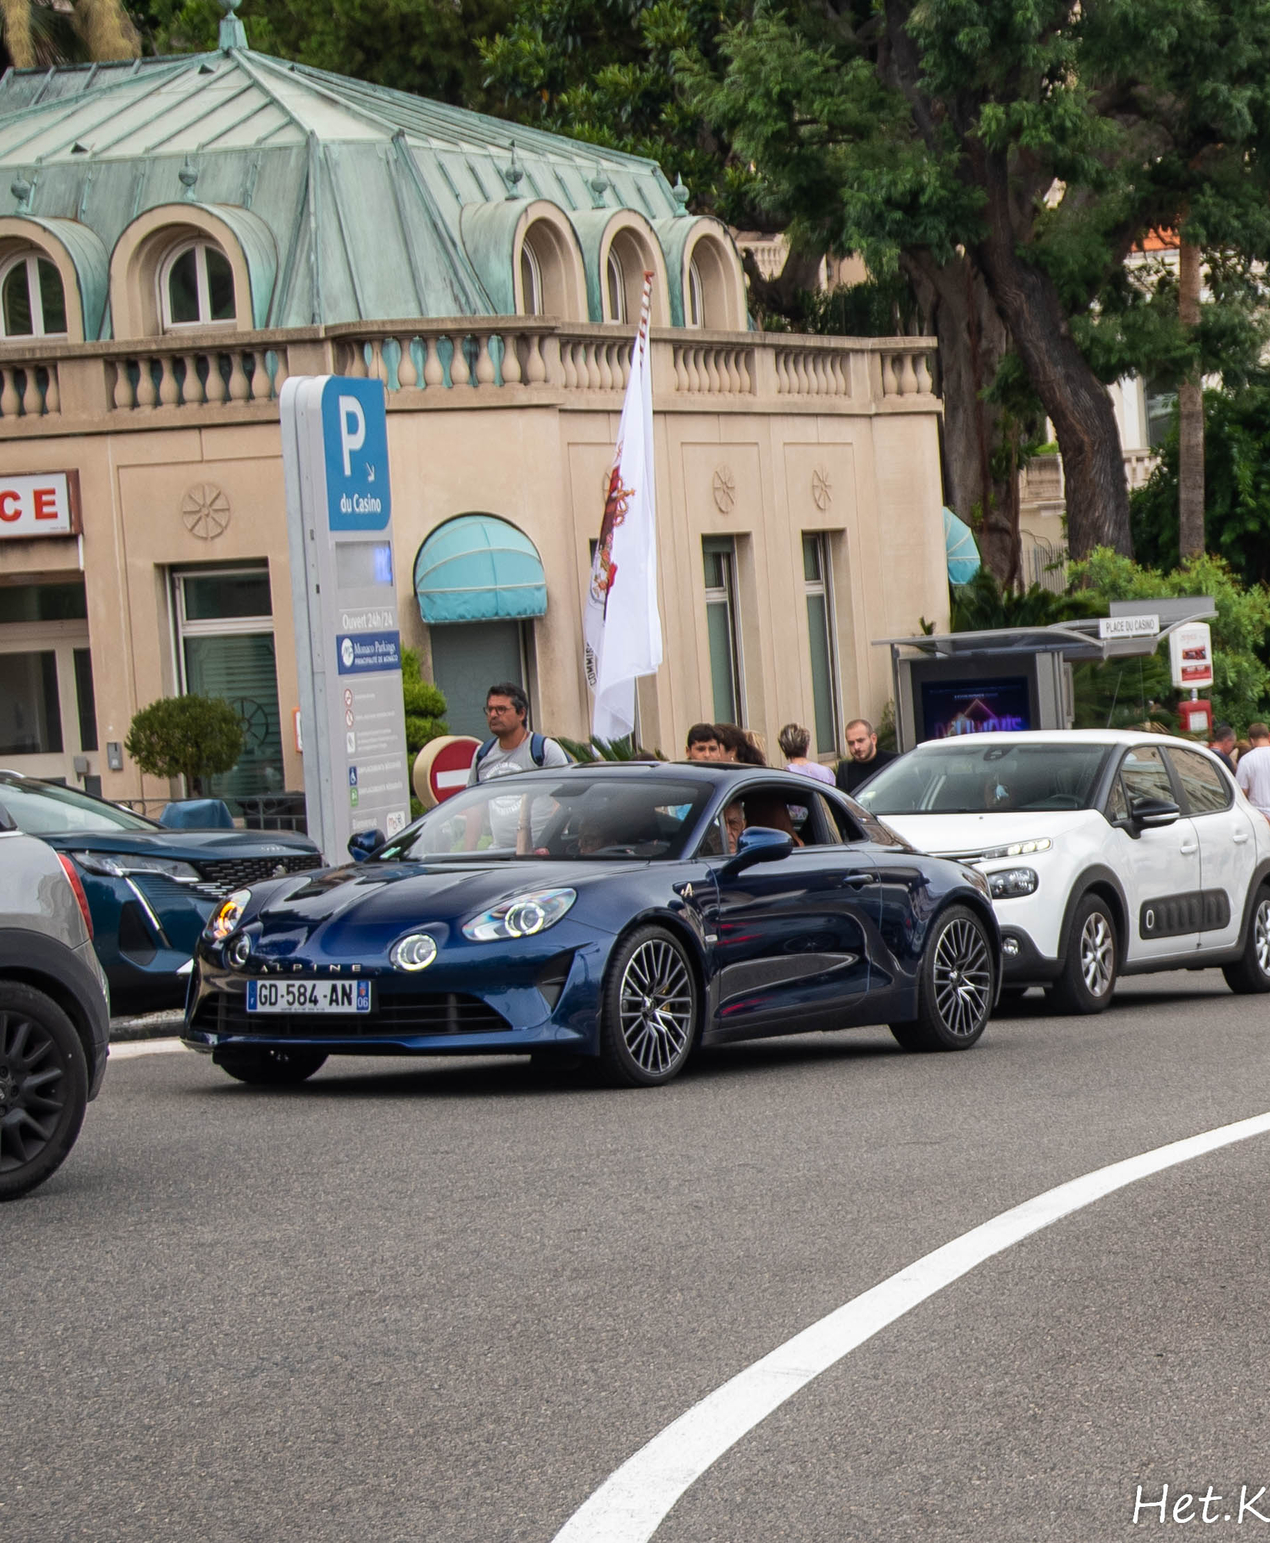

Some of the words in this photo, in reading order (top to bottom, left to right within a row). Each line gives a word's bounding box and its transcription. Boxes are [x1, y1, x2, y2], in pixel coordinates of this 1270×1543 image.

[338, 395, 367, 478] P
[340, 494, 352, 513] du
[353, 493, 382, 514] Casino
[342, 613, 368, 630] Ouvert
[368, 611, 394, 628] 24h/24
[1106, 621, 1124, 633] PLACE
[1126, 620, 1133, 631] DU
[1134, 618, 1155, 630] CASINO
[354, 642, 374, 655] Monaco
[374, 640, 396, 656] Parkings
[261, 963, 362, 973] ALPINE
[258, 983, 353, 1007] GD-584-AN
[357, 997, 369, 1008] 06
